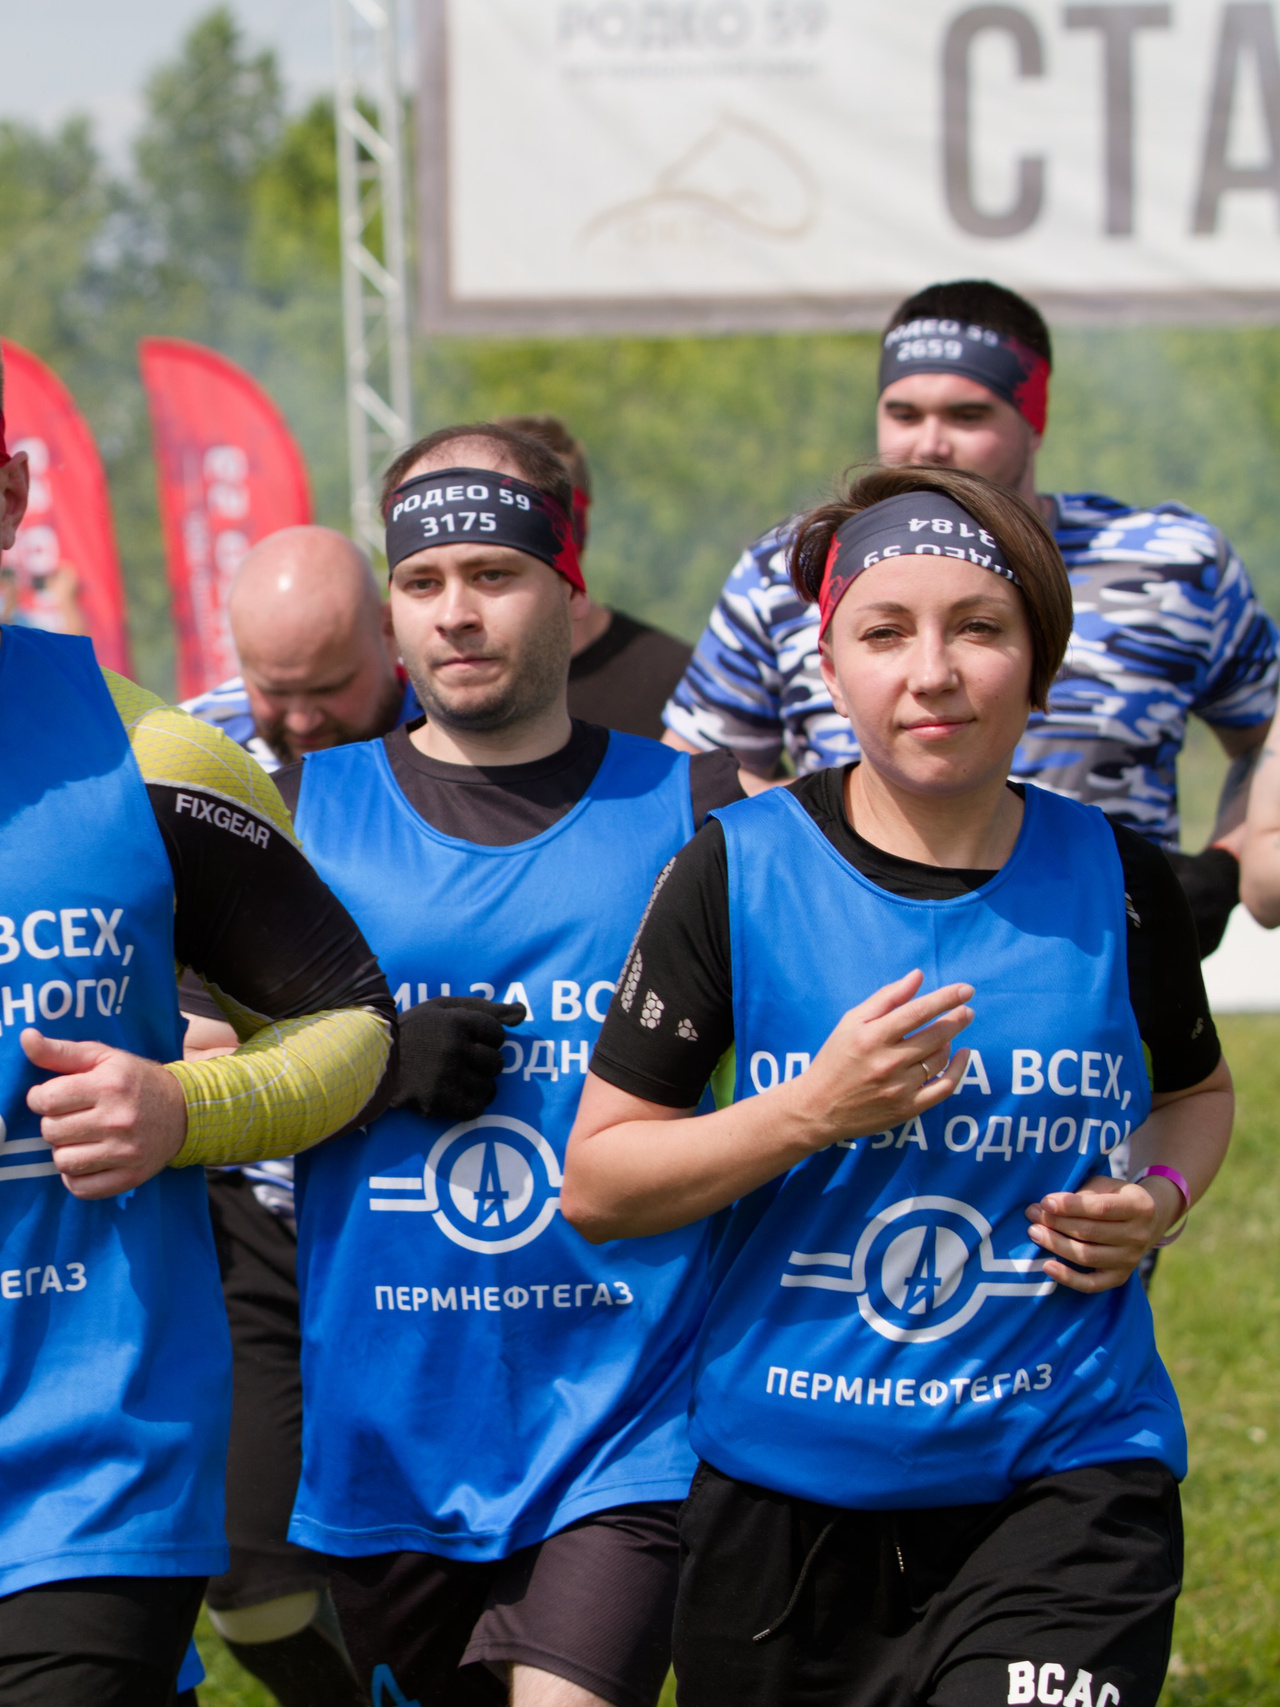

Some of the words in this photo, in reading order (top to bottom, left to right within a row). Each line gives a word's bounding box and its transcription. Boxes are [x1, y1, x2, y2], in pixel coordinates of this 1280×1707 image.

[896, 338, 963, 362] 2659
[392, 485, 489, 522] РОДЕО
[498, 488, 531, 511] 59
[420, 511, 497, 537] 3175
[908, 518, 997, 549] 3184
[175, 792, 271, 850] FIXGEAR
[1011, 1048, 1132, 1110] ВСЕХ,
[375, 1281, 634, 1312] ПЕРМНЕФТЕГАЗ
[766, 1363, 1053, 1407] ПЕРМНЕФТЕГАЗ
